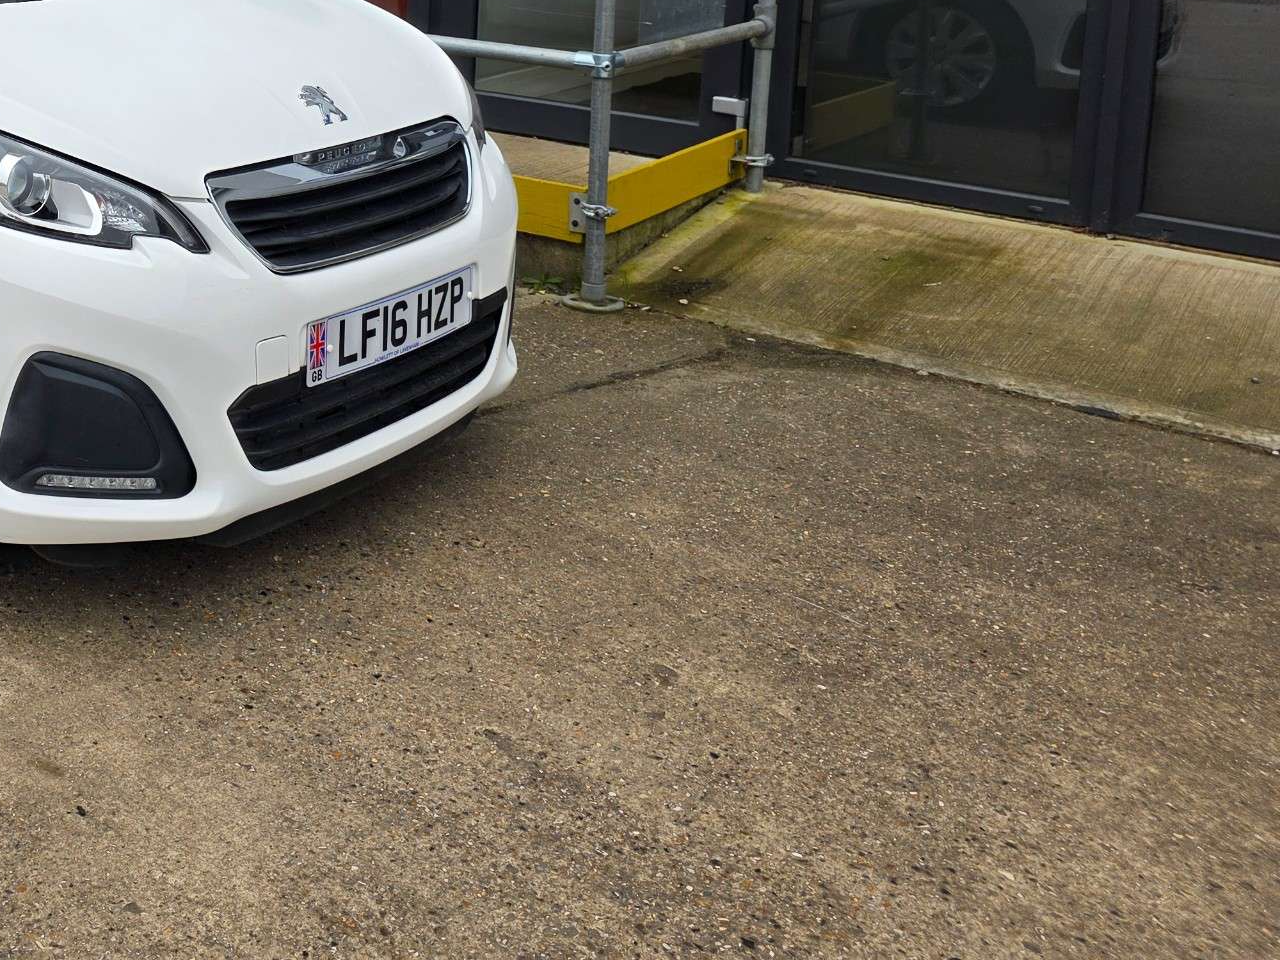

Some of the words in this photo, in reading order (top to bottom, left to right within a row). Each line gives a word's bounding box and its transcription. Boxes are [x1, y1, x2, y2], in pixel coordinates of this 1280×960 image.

[338, 300, 408, 367] LF16
[416, 276, 464, 339] HZP
[311, 369, 323, 383] GB
